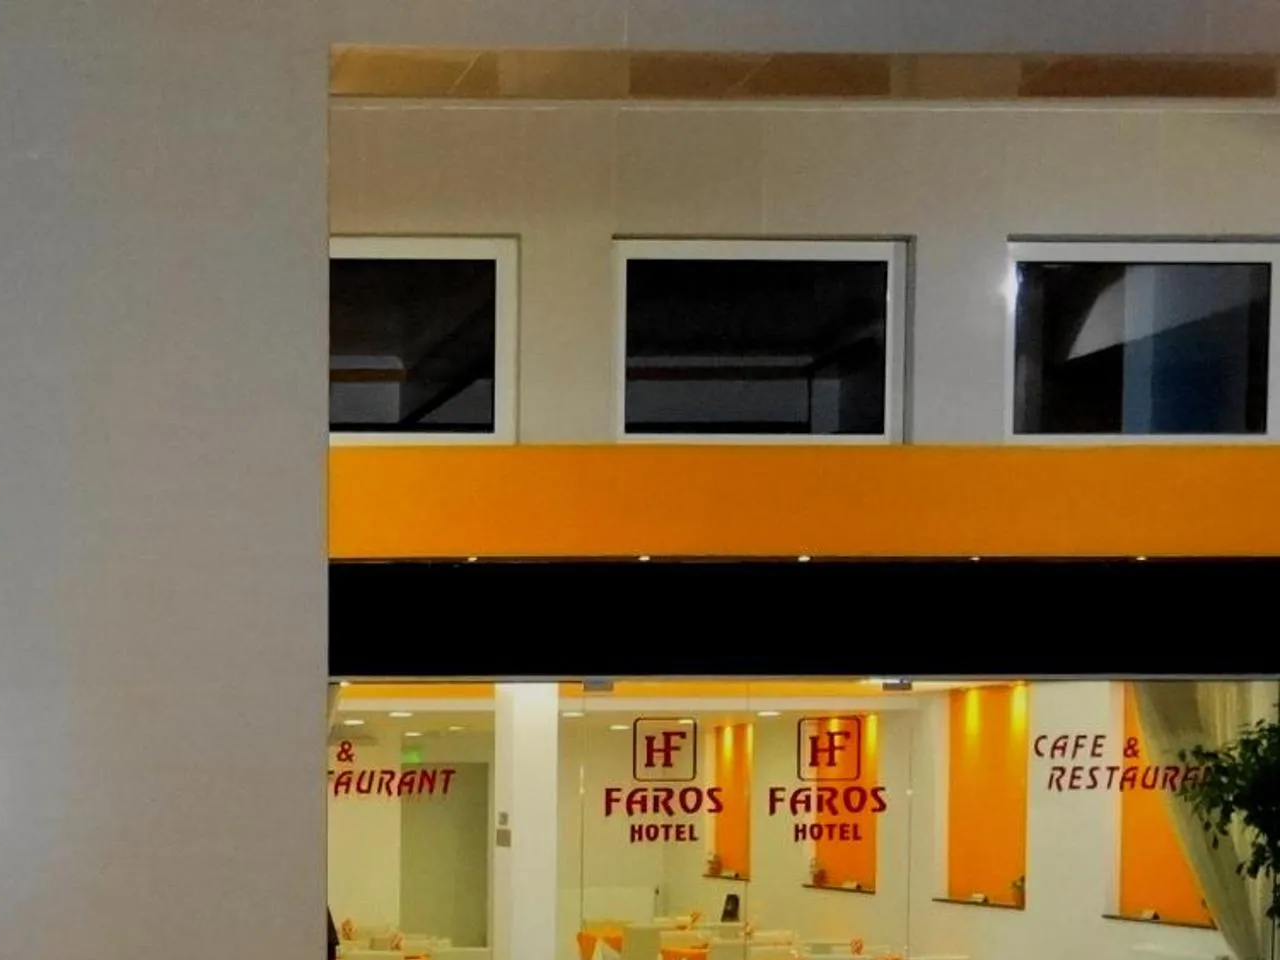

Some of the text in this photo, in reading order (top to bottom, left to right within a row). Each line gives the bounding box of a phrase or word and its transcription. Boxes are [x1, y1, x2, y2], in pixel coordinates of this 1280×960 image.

[336, 740, 355, 762] &
[644, 731, 687, 768] HF
[808, 730, 851, 767] HF
[1033, 734, 1140, 759] CAFE &
[327, 768, 457, 797] AURANT
[604, 786, 724, 817] FAROS
[768, 786, 887, 816] FAROS
[630, 823, 699, 843] HOTEL
[794, 822, 862, 842] HOTEL
